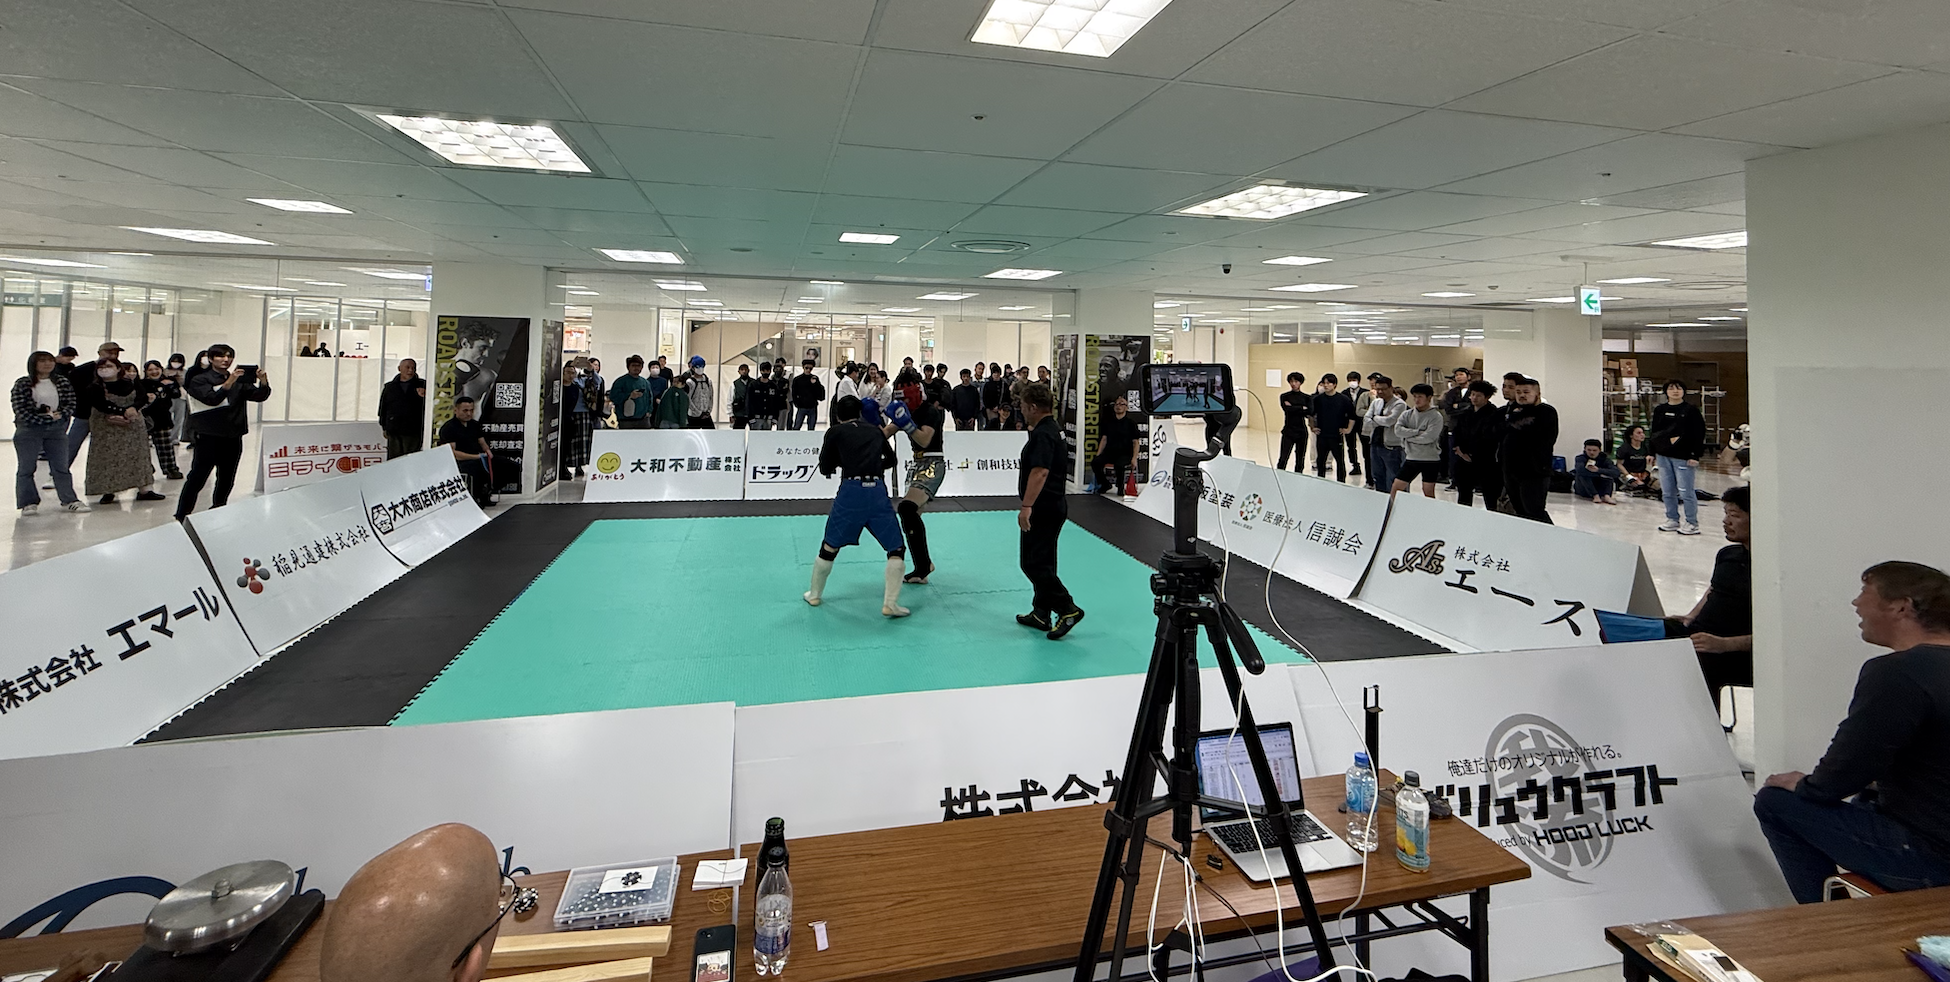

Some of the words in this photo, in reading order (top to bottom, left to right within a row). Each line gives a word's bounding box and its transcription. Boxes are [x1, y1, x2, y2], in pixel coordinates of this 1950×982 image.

[482, 423, 524, 433] 不動産売買
[489, 440, 524, 450] 売却査定
[776, 447, 820, 455] あなたの健
[630, 457, 722, 473] 大和不動産
[724, 456, 742, 464] 株式
[724, 464, 741, 472] 会社
[752, 465, 814, 480] ドラッグ
[388, 475, 467, 522] 大木商店株式会社
[1262, 510, 1303, 534] 医療法人
[1305, 520, 1364, 556] 信誠会
[1454, 546, 1511, 573] 株式会社
[1444, 568, 1586, 637] エース
[0, 643, 103, 715] 株式会社
[106, 586, 220, 661] エマール
[1447, 744, 1622, 778] 俺達だけのオリジナルが作れる。
[1434, 764, 1678, 828] リュウクラフト
[1520, 832, 1531, 846] by
[1598, 815, 1655, 838] LUCK
